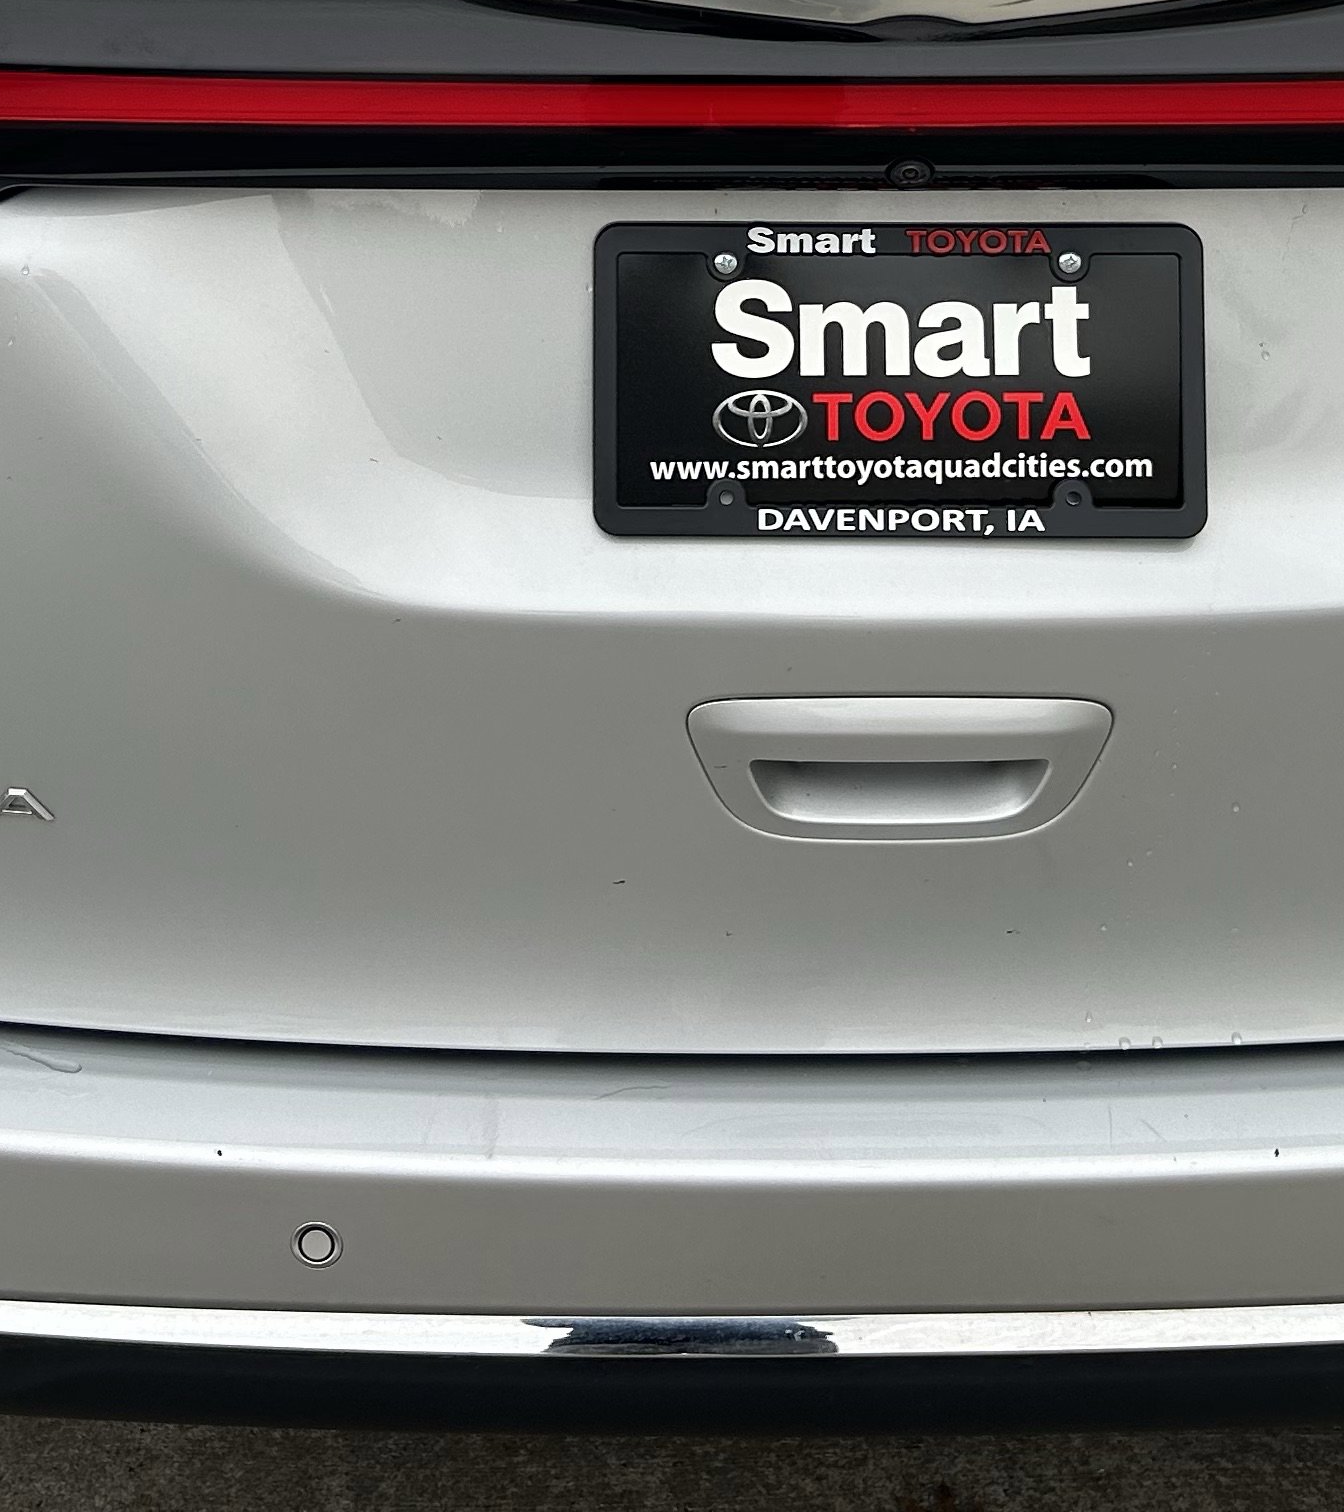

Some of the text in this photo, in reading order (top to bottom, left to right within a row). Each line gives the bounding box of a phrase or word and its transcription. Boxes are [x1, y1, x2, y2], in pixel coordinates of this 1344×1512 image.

[747, 226, 1051, 255] Smart TOYOTA
[711, 279, 1091, 379] Smart
[812, 391, 1091, 442] TOYOTA
[650, 450, 1153, 486] www.smarttoyotaquadcities.com
[757, 506, 1046, 537] DAVENPORT, IA
